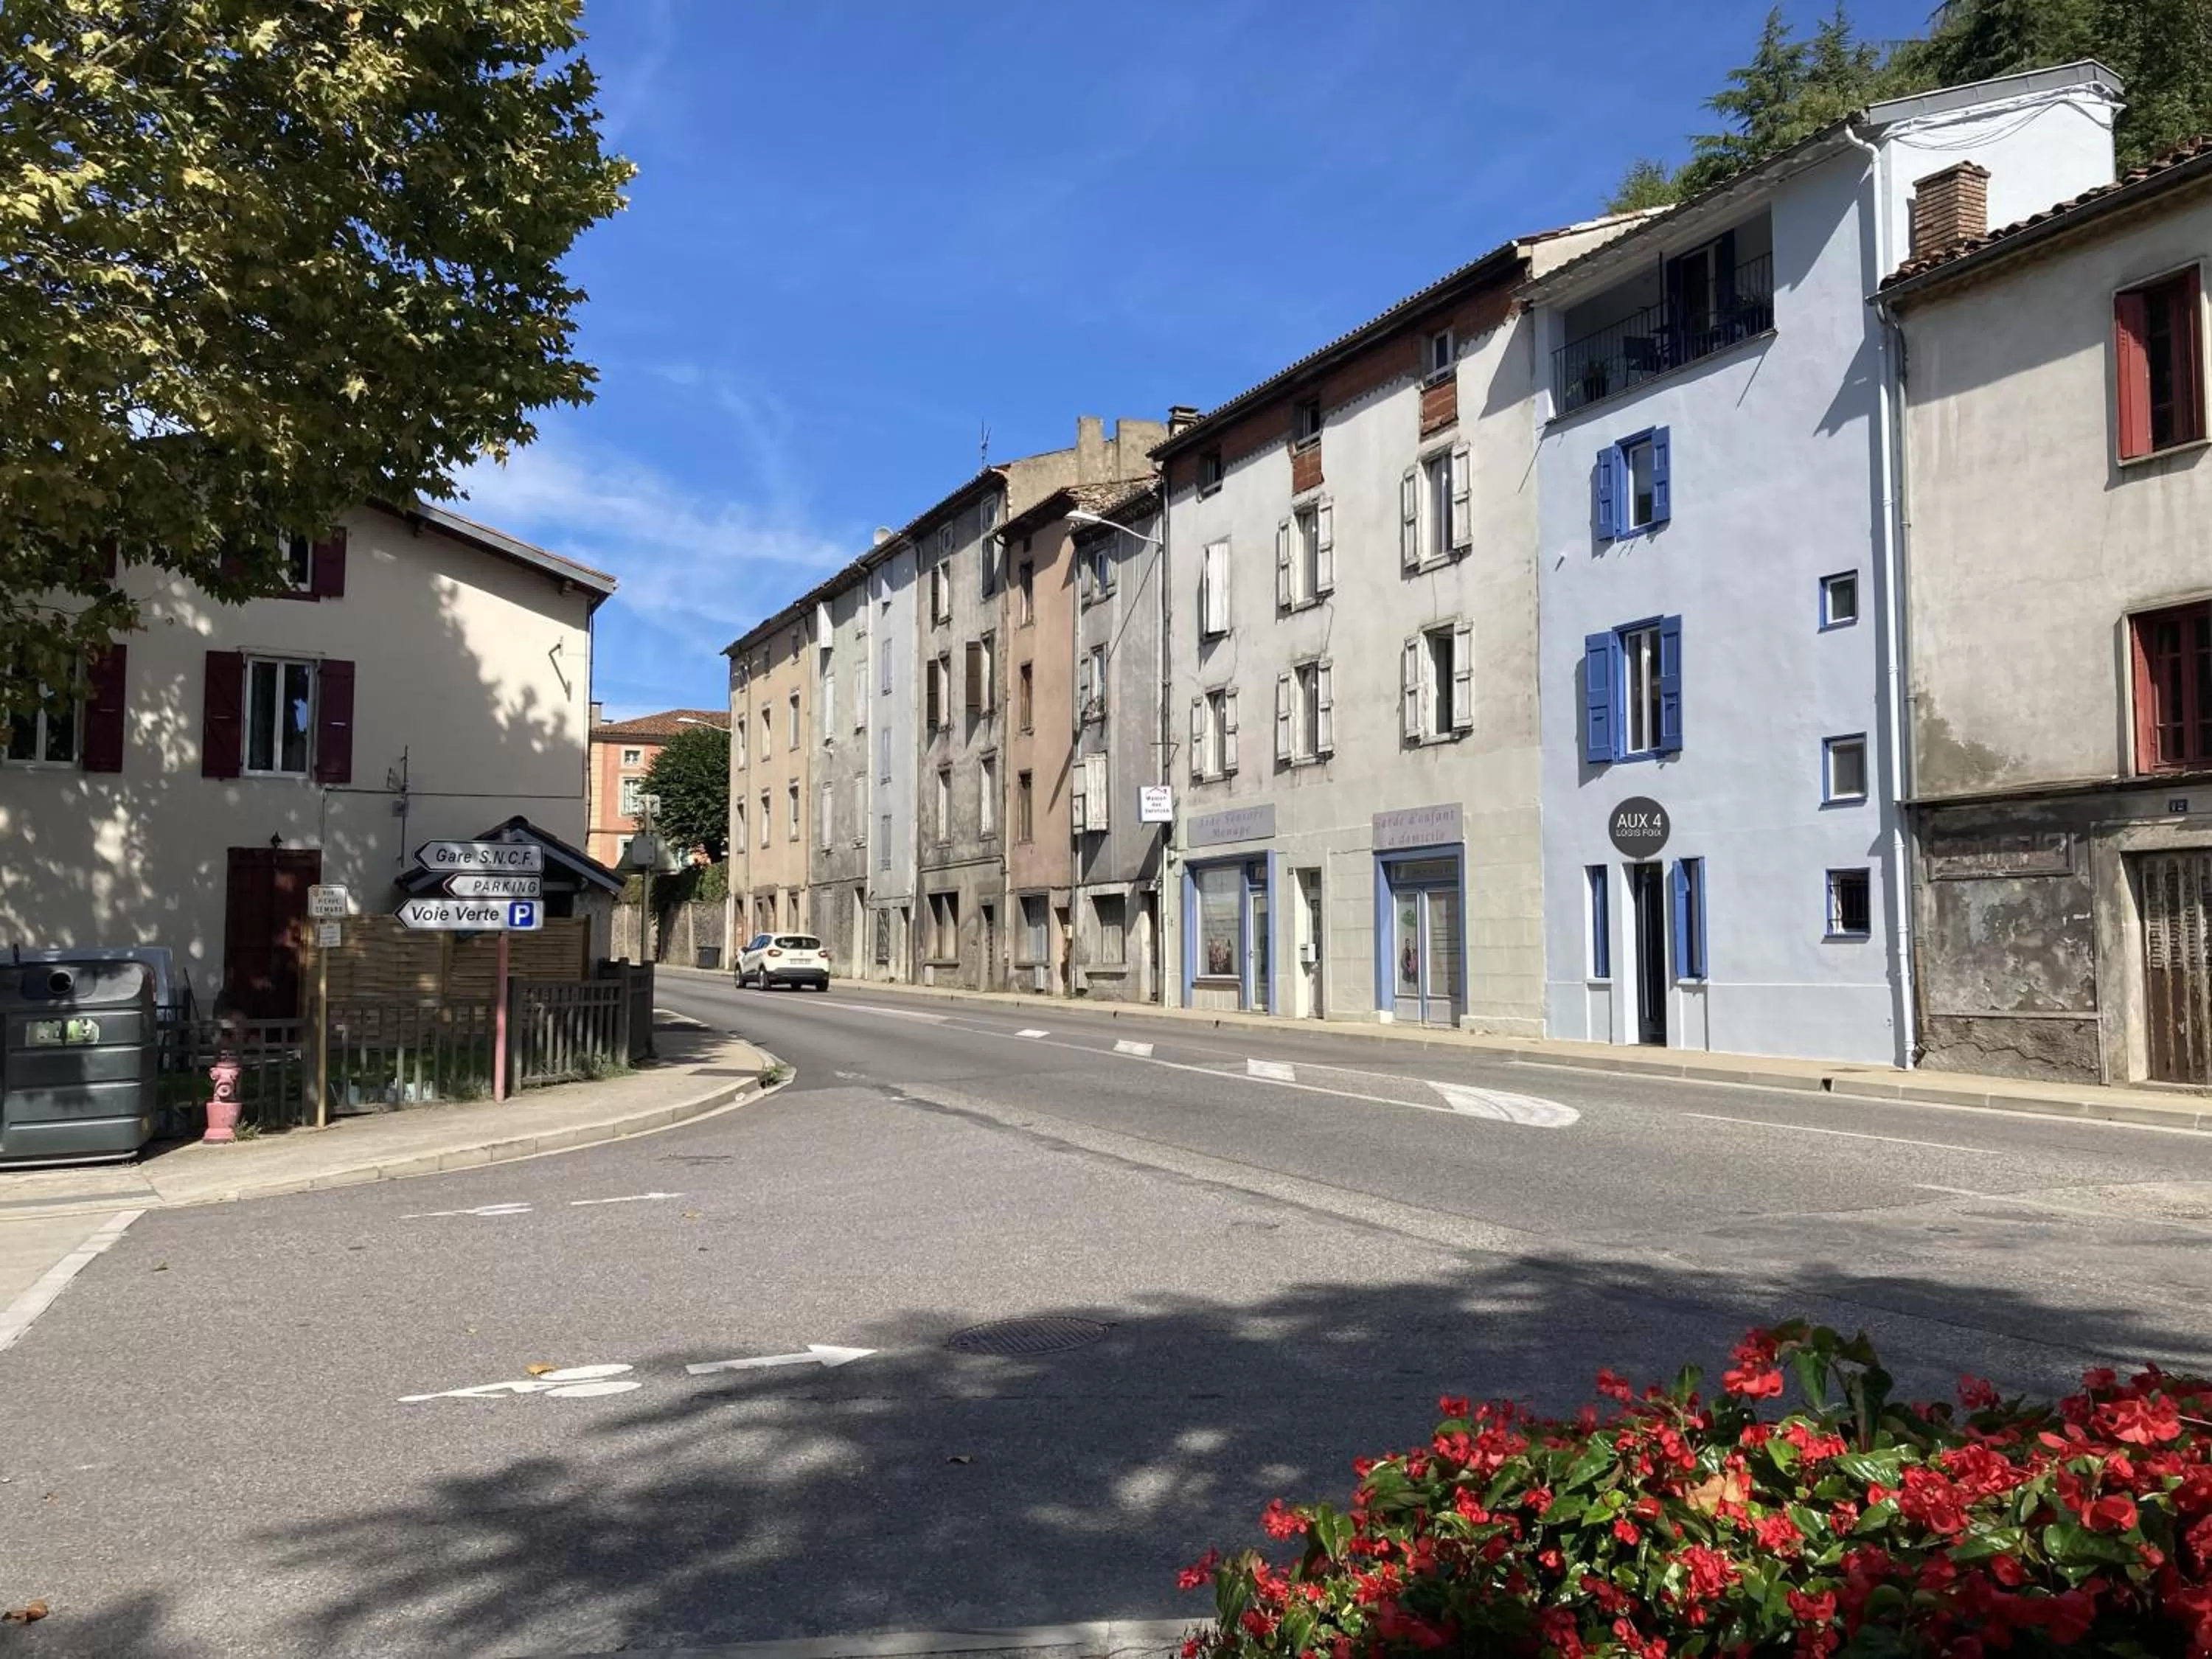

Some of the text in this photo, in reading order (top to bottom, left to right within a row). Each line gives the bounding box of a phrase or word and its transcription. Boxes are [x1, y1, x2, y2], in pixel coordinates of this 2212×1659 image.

[1616, 813, 1663, 828] AUX 4
[1642, 828, 1663, 837] FOIX
[436, 848, 534, 866] Gare S.N.C.F.
[473, 881, 537, 894] PARKING
[412, 906, 449, 921] Voie
[456, 906, 499, 921] Verte
